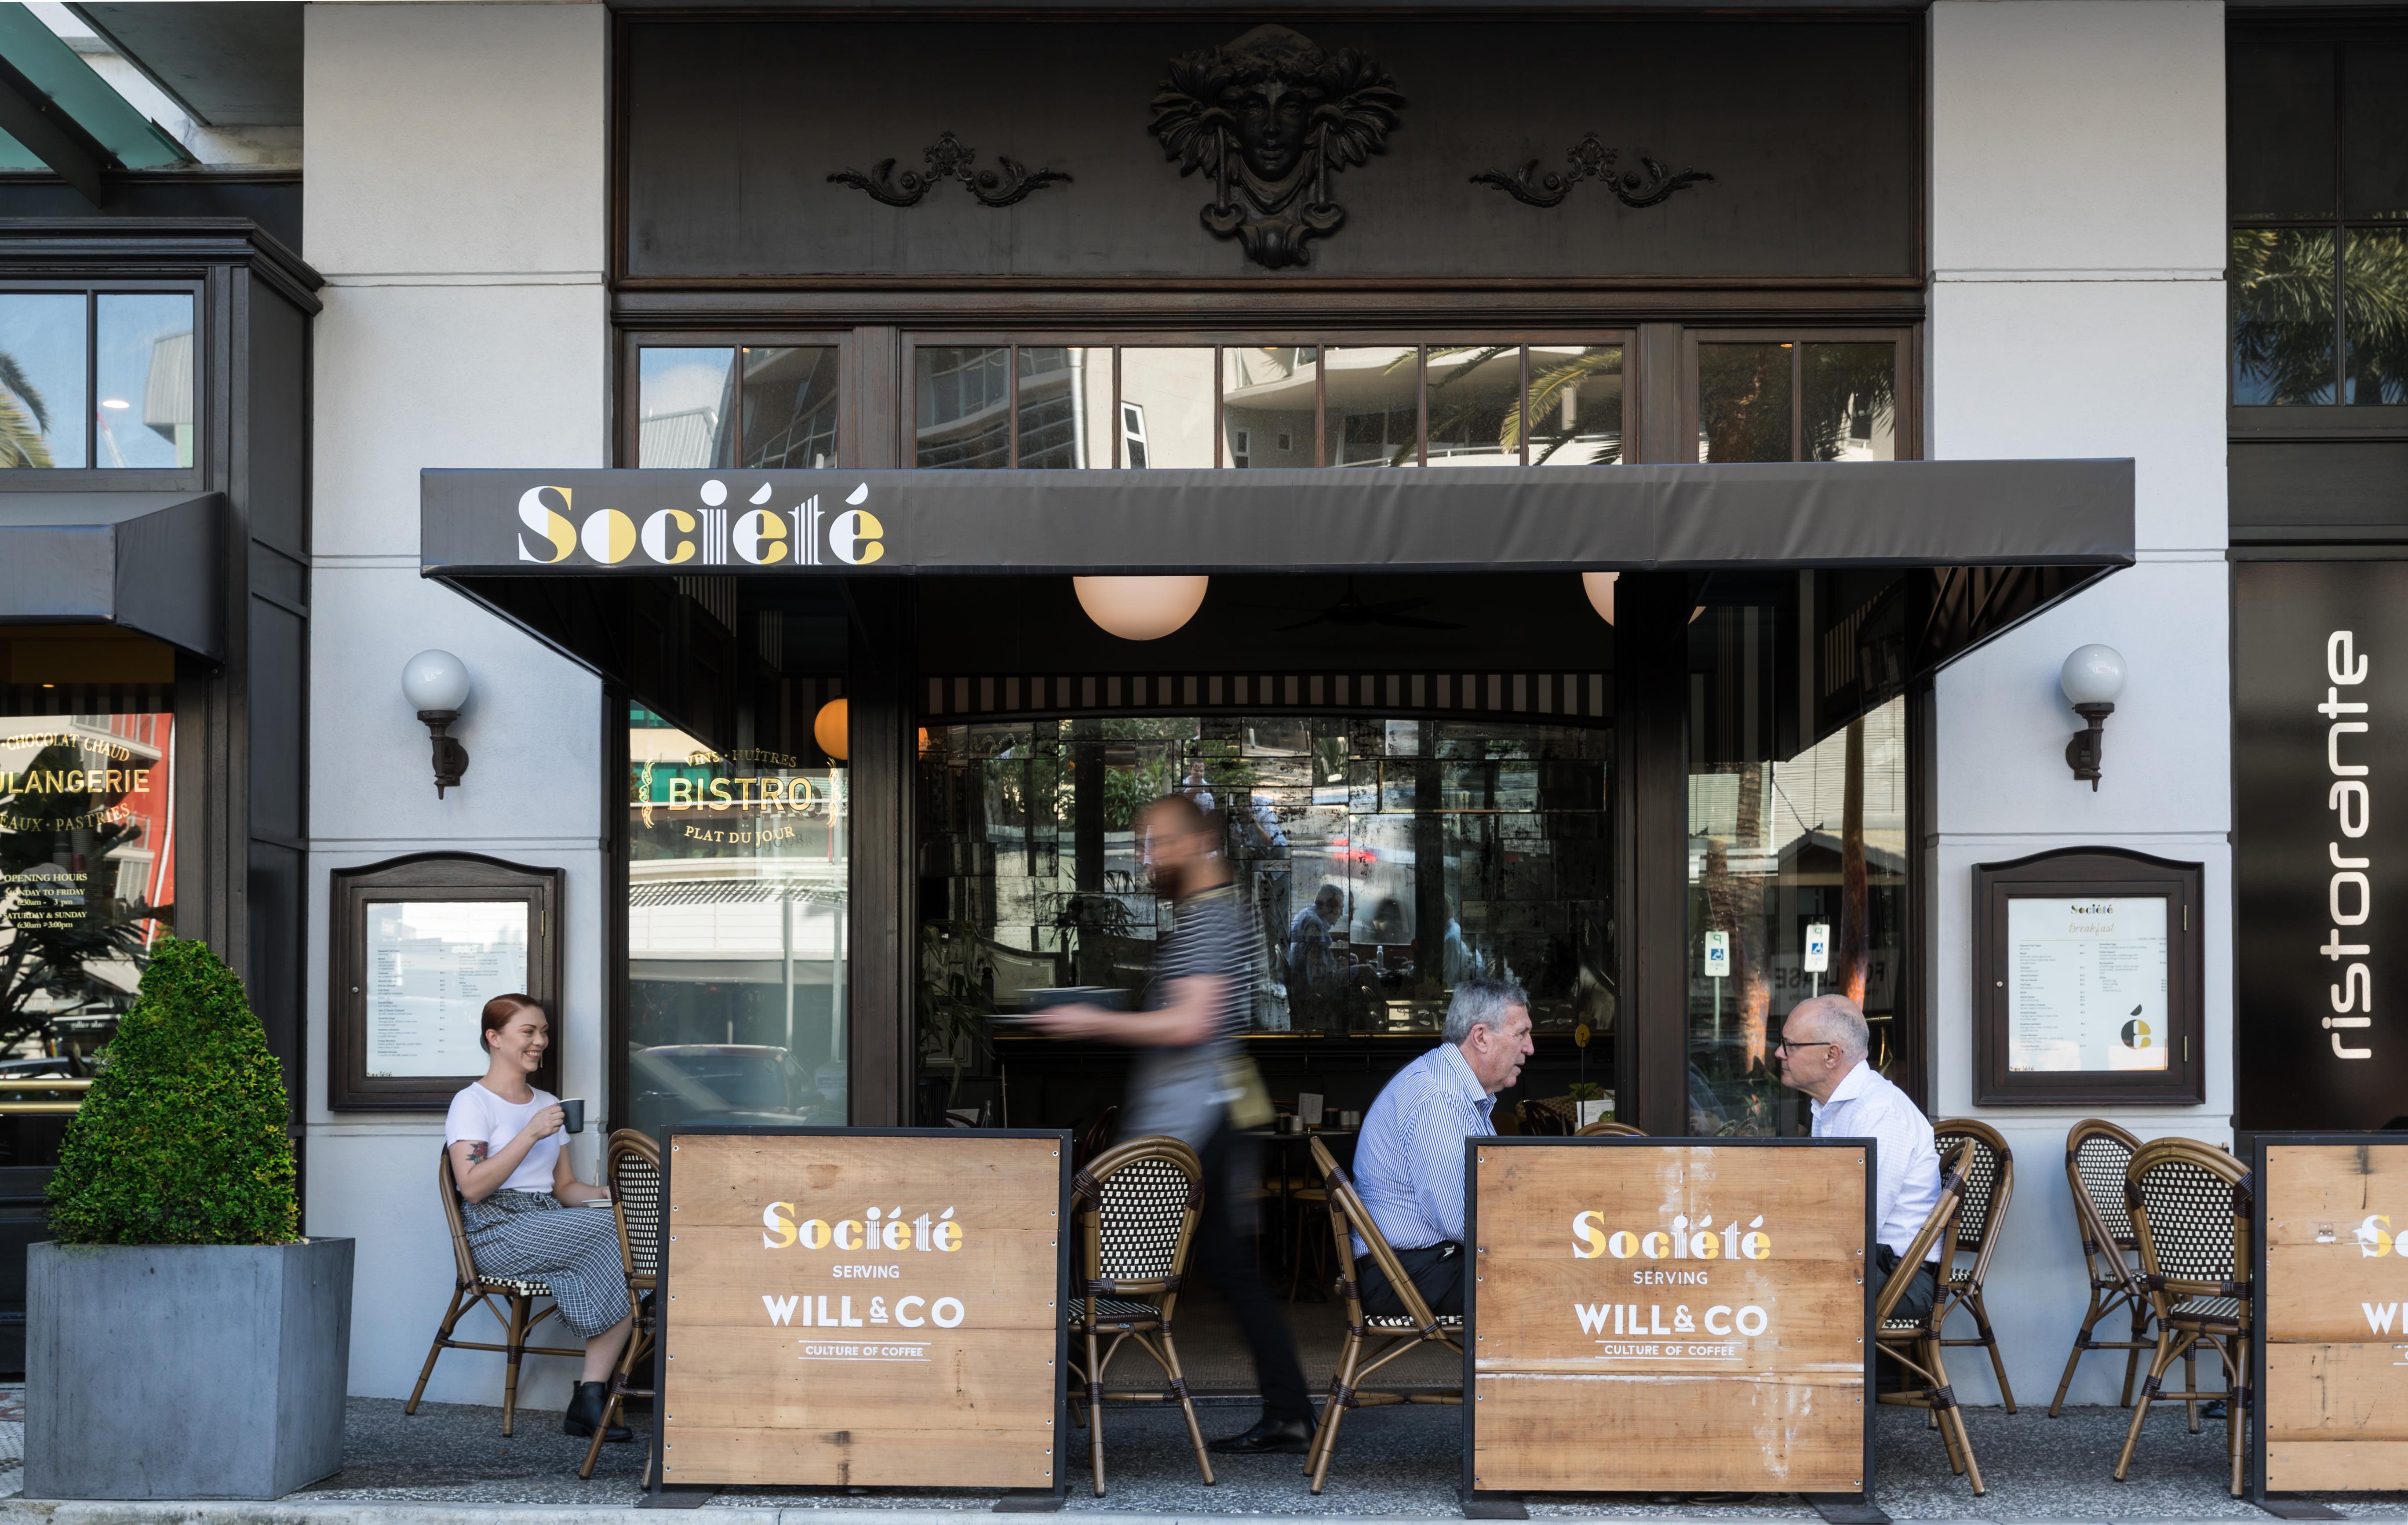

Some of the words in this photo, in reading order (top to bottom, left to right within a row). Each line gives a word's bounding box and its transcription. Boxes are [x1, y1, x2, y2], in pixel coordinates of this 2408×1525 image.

[518, 480, 884, 564] Société
[7, 732, 80, 750] CHOCOLAT
[84, 738, 130, 761] CHAUD
[684, 751, 720, 767] VINS
[732, 748, 797, 768] HUÎTRES
[668, 777, 812, 811] BISTRO
[56, 803, 130, 832] PASTRIES
[684, 826, 724, 842] PLAT
[729, 832, 751, 844] DU
[755, 826, 795, 846] JOUR
[2318, 630, 2372, 1059] ristorante
[2071, 904, 2113, 914] Société
[48, 921, 73, 930] 3:00pm
[2069, 922, 2115, 936] Breakfast
[763, 1201, 962, 1252] Société
[1572, 1210, 1771, 1259] Société
[833, 1265, 900, 1278] SERVING
[1633, 1271, 1708, 1285] SERVING
[805, 1346, 859, 1356] CULTURE
[863, 1346, 878, 1356] OF
[882, 1347, 924, 1357] COFFEE
[1605, 1345, 1659, 1355] CULTURE
[1665, 1345, 1683, 1355] OF
[1688, 1346, 1734, 1356] COFFEE
